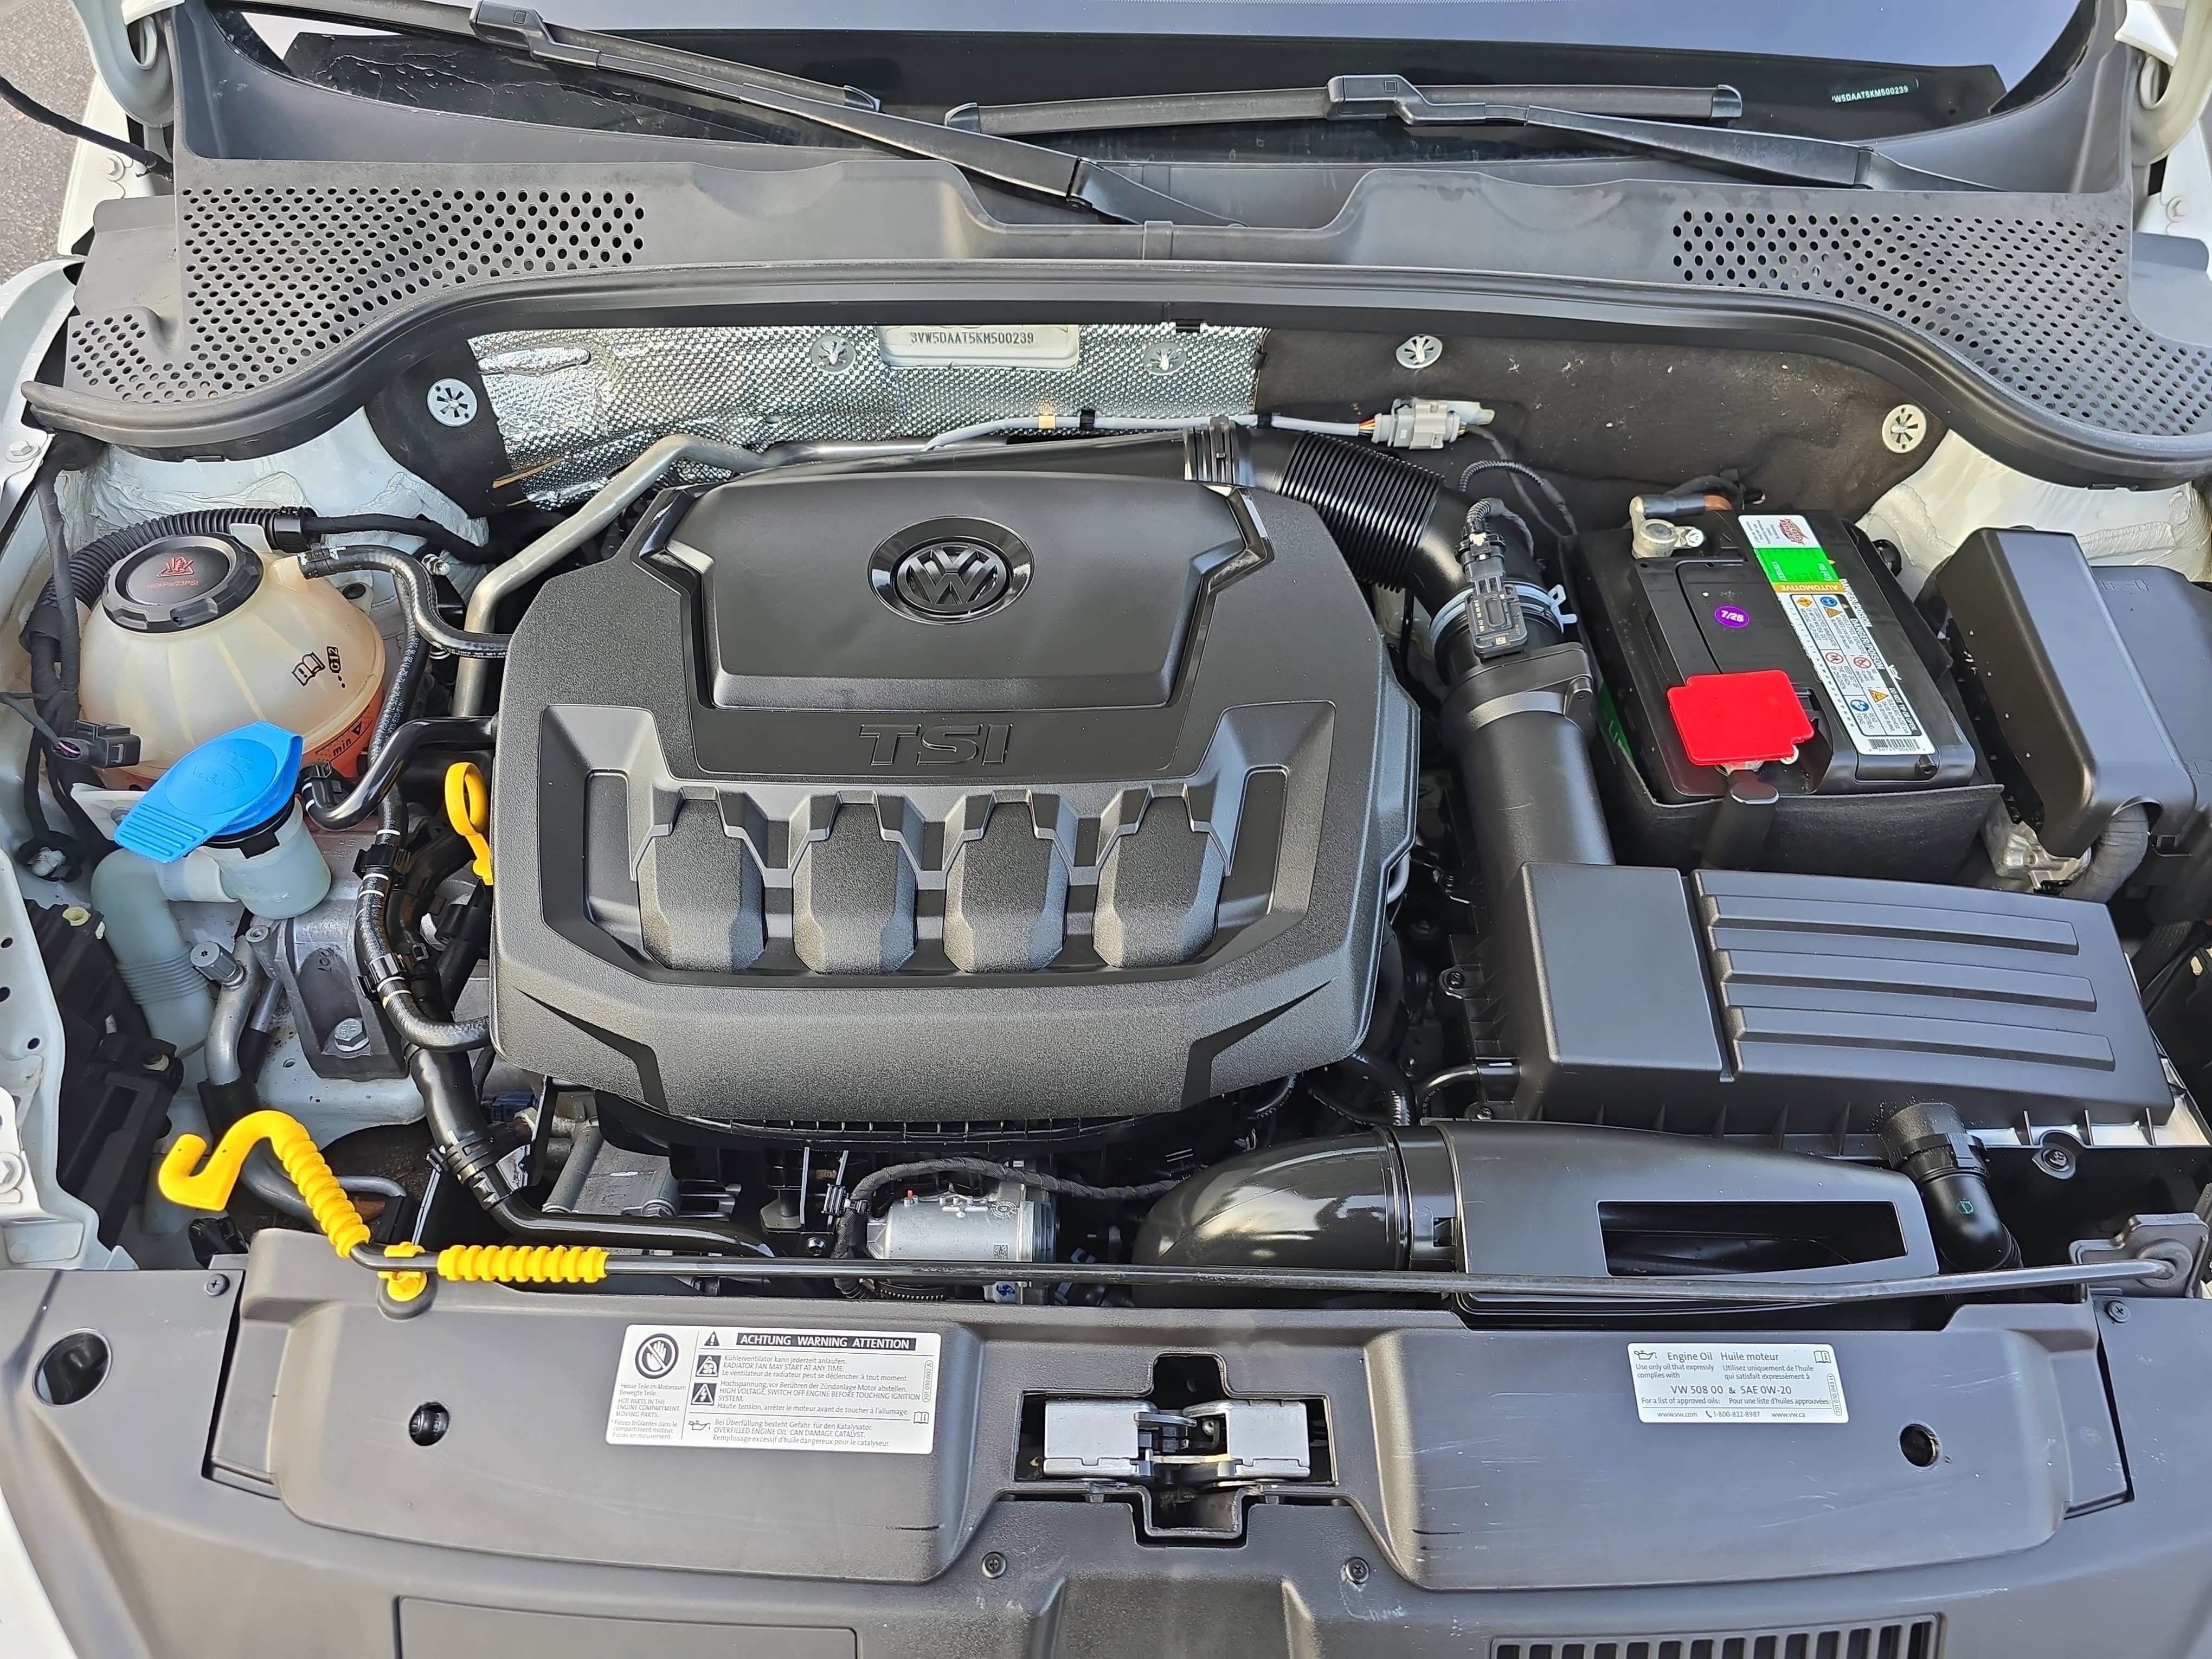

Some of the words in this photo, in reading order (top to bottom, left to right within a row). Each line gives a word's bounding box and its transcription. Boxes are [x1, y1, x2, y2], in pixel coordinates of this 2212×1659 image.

[1838, 577, 1874, 628] DANGER/POISON
[1721, 609, 1745, 623] 7/25
[1850, 618, 1886, 670] DANGER/POISON
[328, 647, 340, 671] G12
[332, 738, 352, 757] min
[859, 723, 1013, 767] TSI
[740, 1335, 791, 1345] ACHTUNG
[798, 1336, 847, 1346] WARNING
[852, 1338, 909, 1348] ATTENTION
[789, 1356, 816, 1365] jederzeit
[1667, 1352, 1698, 1362] Engine
[1700, 1352, 1713, 1360] Oil
[1720, 1352, 1745, 1360] Huile
[1746, 1352, 1778, 1360] moteur
[1648, 1363, 1662, 1371] only
[1746, 1364, 1785, 1372] uniquement
[720, 1380, 768, 1389] Hochspannung,
[819, 1383, 856, 1392] Zündanlage
[1670, 1385, 1687, 1394] VW
[1690, 1385, 1708, 1394] 508
[1710, 1385, 1723, 1394] 00
[1740, 1385, 1758, 1394] SAE
[1760, 1385, 1791, 1394] 0W-20
[1676, 1397, 1706, 1405] approved
[1794, 1398, 1831, 1406] approuvées:
[874, 1407, 909, 1417] l'allumage.
[725, 1418, 763, 1428] Überfüllung
[764, 1419, 788, 1427] besteht
[837, 1423, 872, 1432] Katalysator.
[712, 1434, 751, 1443] Remplissage
[800, 1437, 833, 1445] dangereux
[857, 1439, 890, 1448] catalyseur.
